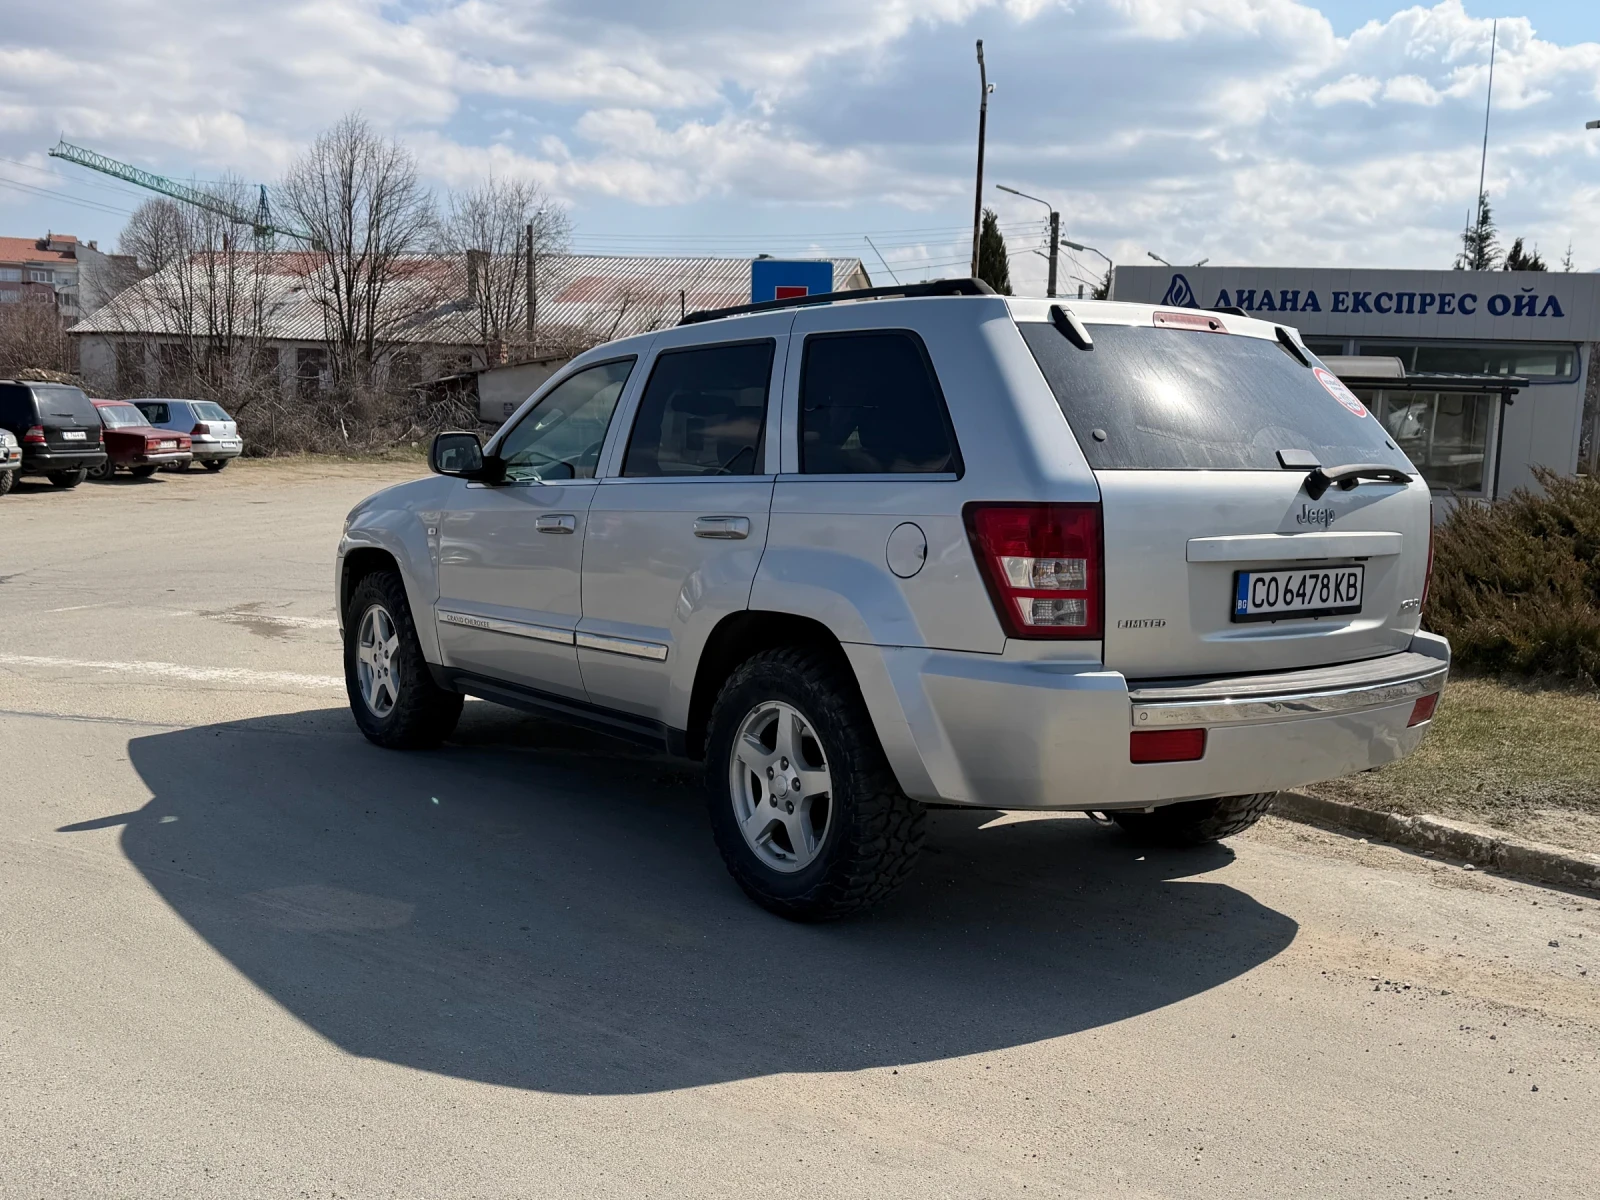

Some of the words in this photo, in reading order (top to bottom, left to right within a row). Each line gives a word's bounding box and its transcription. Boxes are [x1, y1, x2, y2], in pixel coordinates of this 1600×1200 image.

[1330, 291, 1478, 315] ЕКСПРЕС
[1487, 287, 1565, 317] ОЙЛ
[1296, 503, 1335, 528] Jeep
[1237, 599, 1247, 610] BG
[464, 618, 490, 628] CHEROKEE
[1117, 618, 1168, 629] LIMITED
